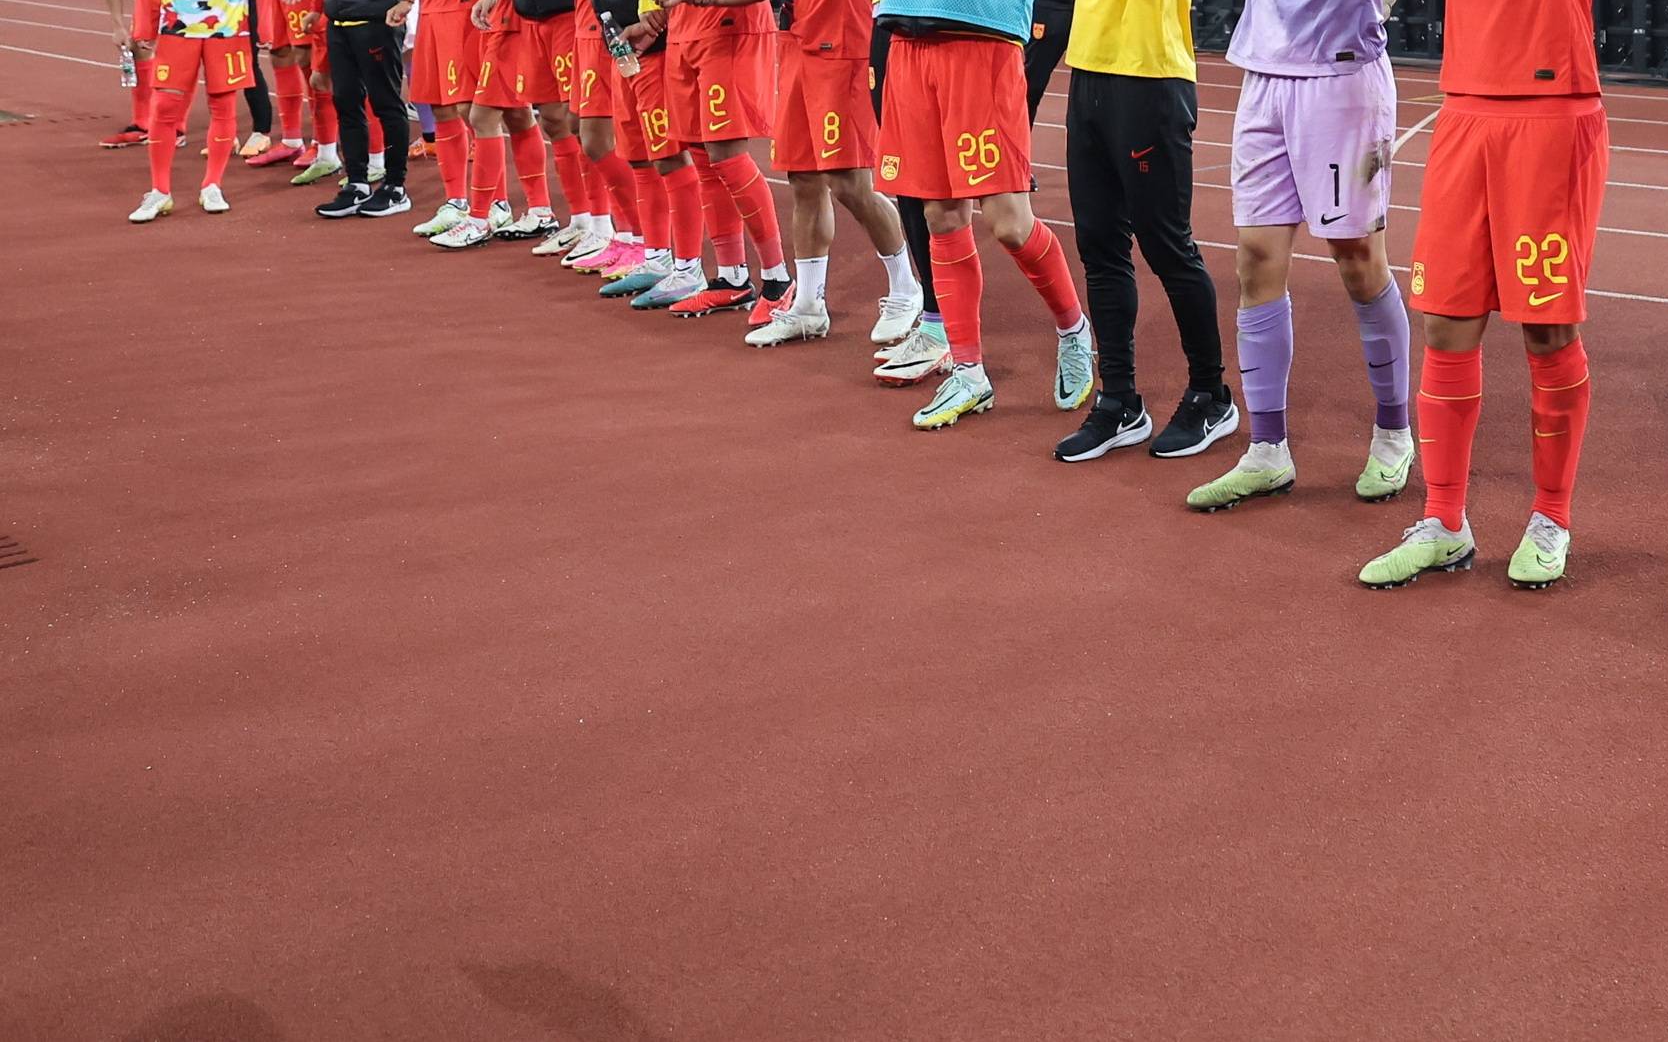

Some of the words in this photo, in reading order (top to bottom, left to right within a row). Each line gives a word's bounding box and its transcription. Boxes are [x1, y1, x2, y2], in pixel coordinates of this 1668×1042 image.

[224, 50, 247, 76] 11
[447, 60, 457, 85] 4
[708, 84, 726, 117] 2
[641, 108, 669, 141] 18
[823, 111, 840, 145] 8
[957, 128, 1001, 172] 26
[1329, 163, 1340, 207] 1
[1515, 232, 1569, 285] 22
